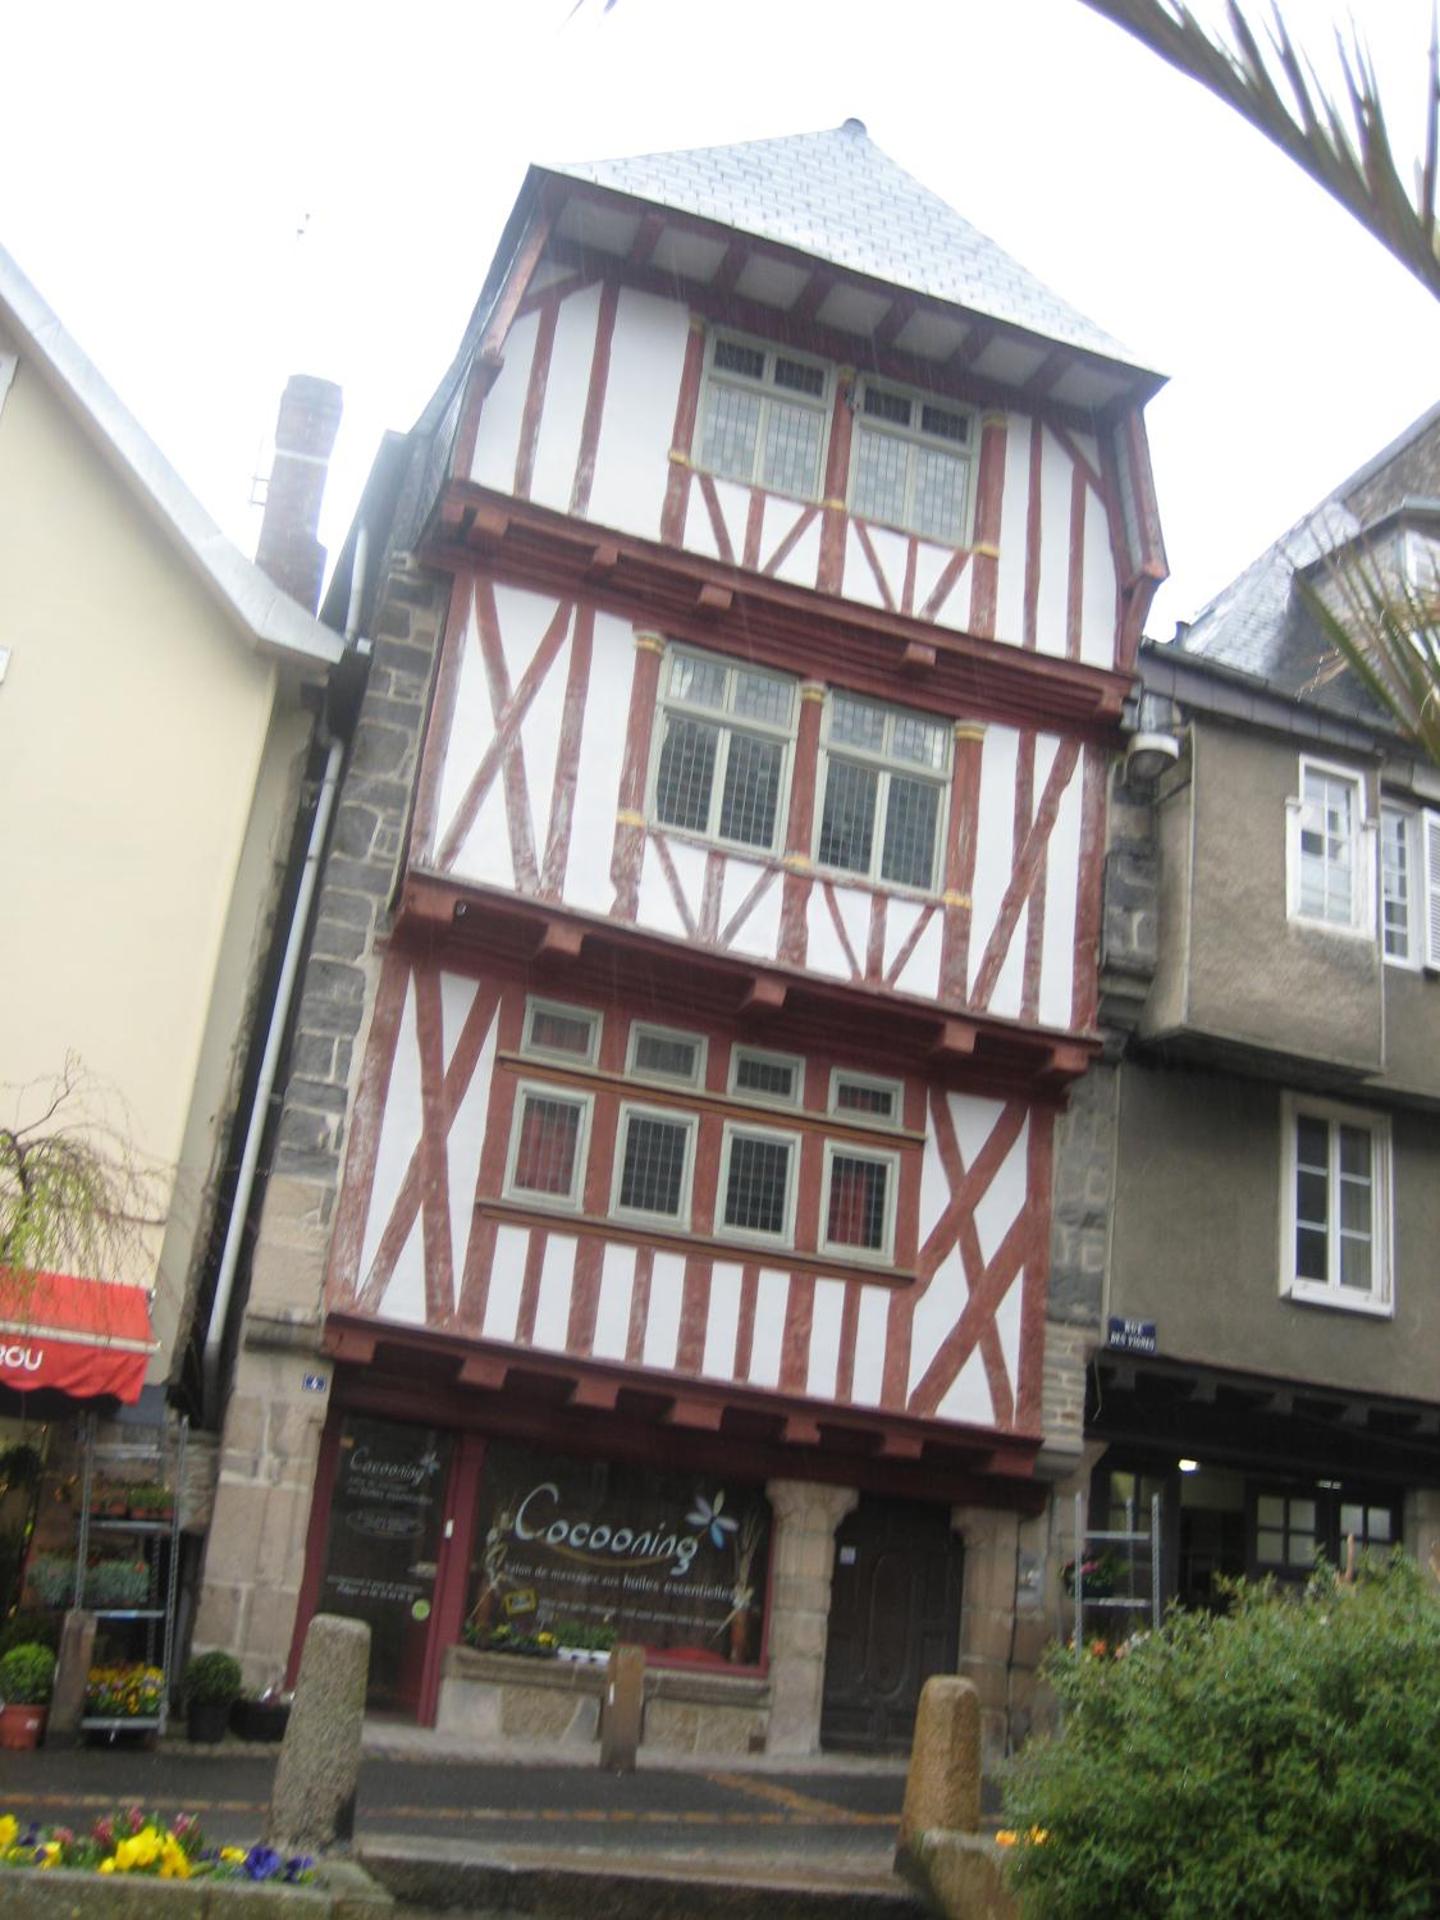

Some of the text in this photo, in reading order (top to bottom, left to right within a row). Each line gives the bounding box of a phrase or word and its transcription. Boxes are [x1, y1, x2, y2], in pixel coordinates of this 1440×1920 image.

[1124, 1319, 1143, 1336] RUE
[350, 1446, 425, 1487] Cocooning
[515, 1482, 698, 1576] Cocooning
[623, 1573, 660, 1592] huiles
